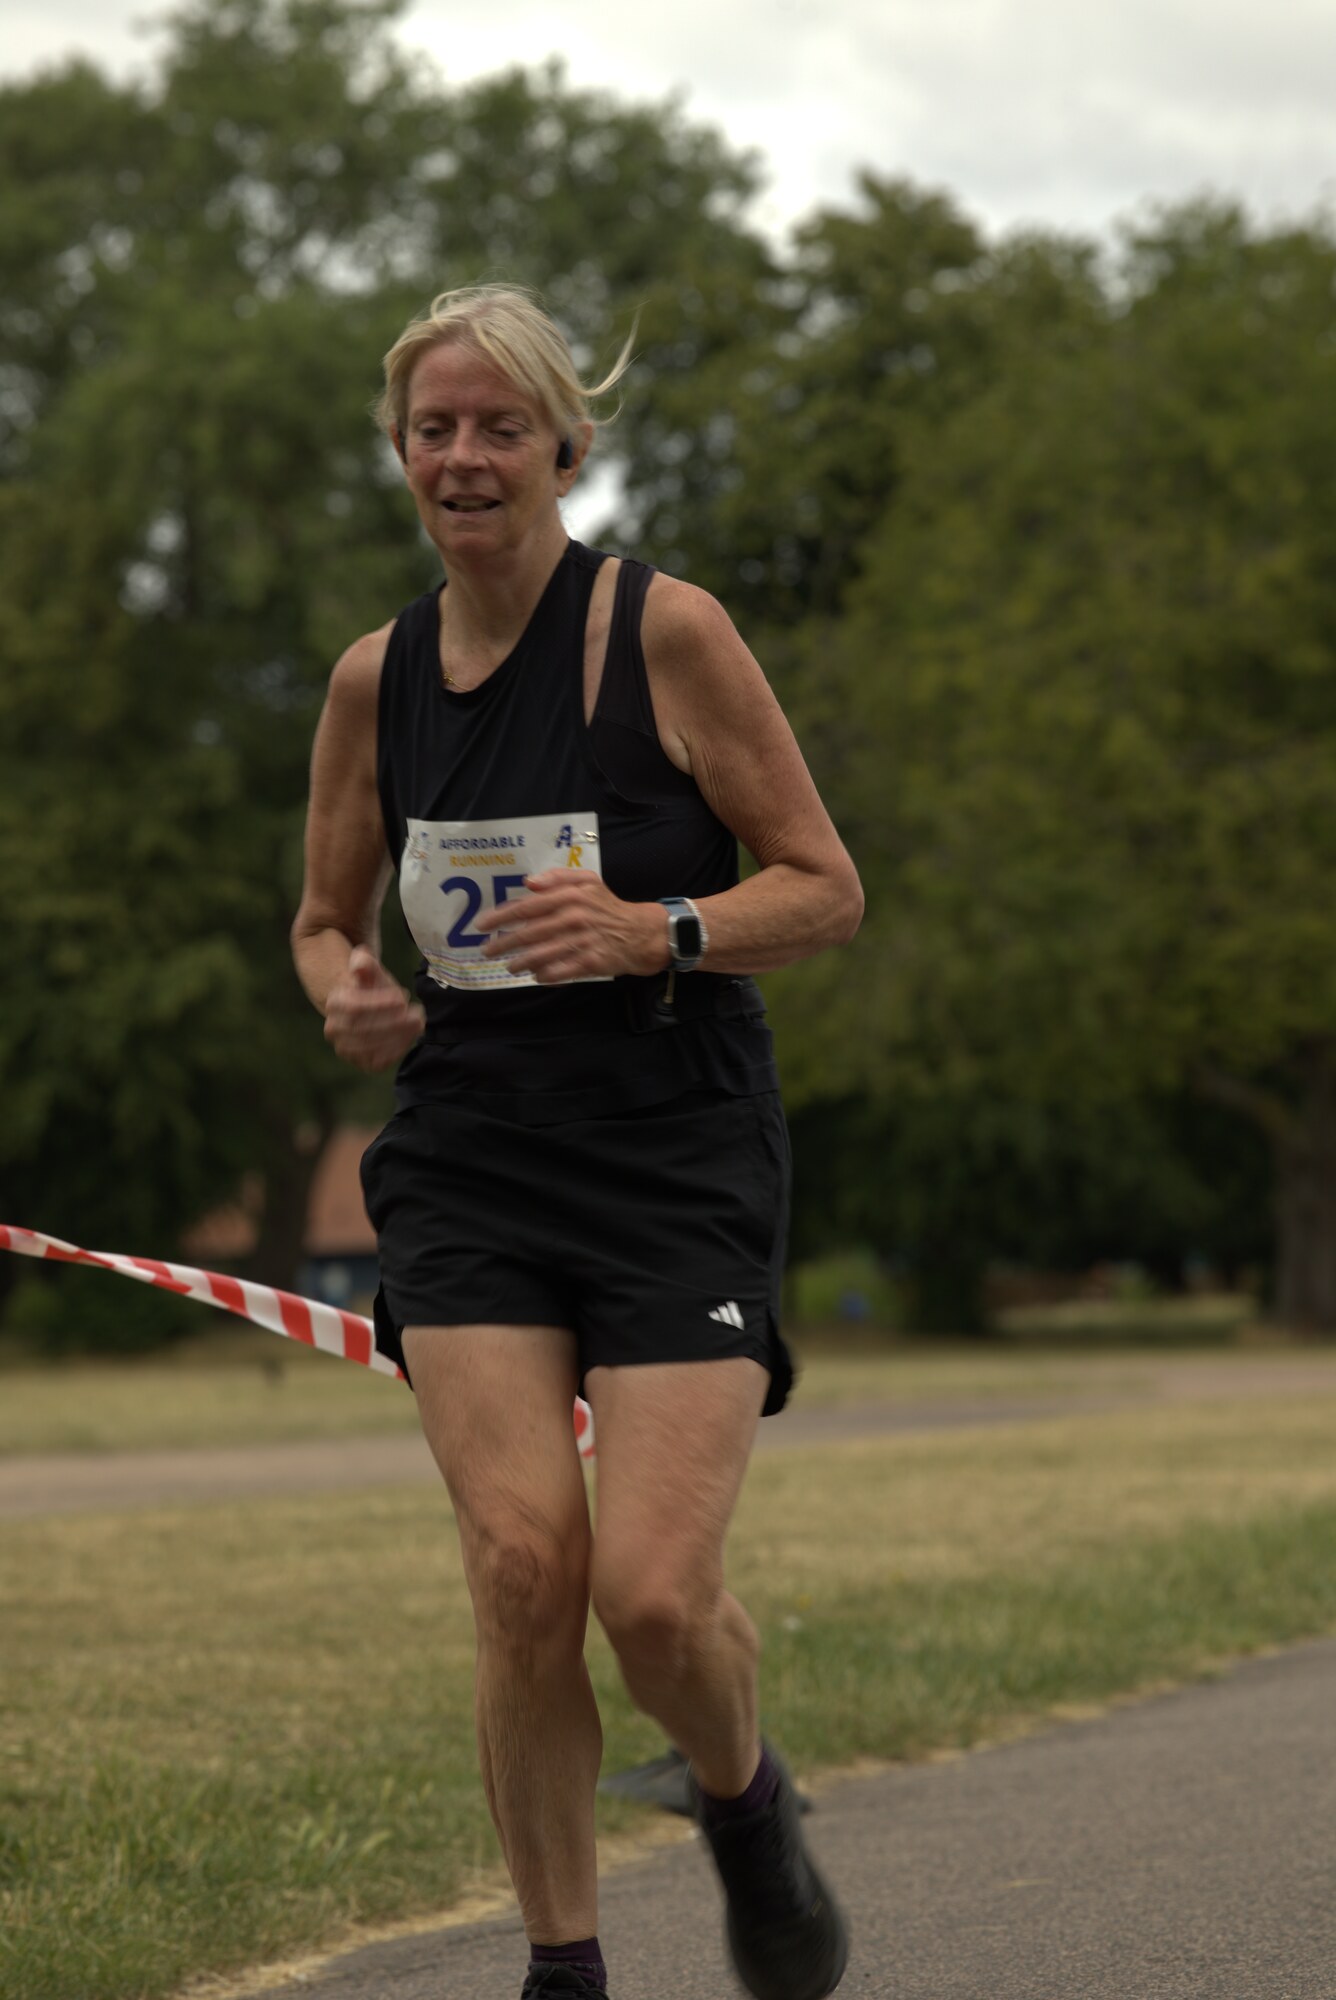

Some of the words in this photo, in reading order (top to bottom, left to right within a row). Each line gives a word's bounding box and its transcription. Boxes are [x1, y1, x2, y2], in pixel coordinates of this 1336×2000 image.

[439, 835, 526, 851] AFFORDABLE
[449, 852, 516, 868] RUNNING
[567, 845, 583, 867] R
